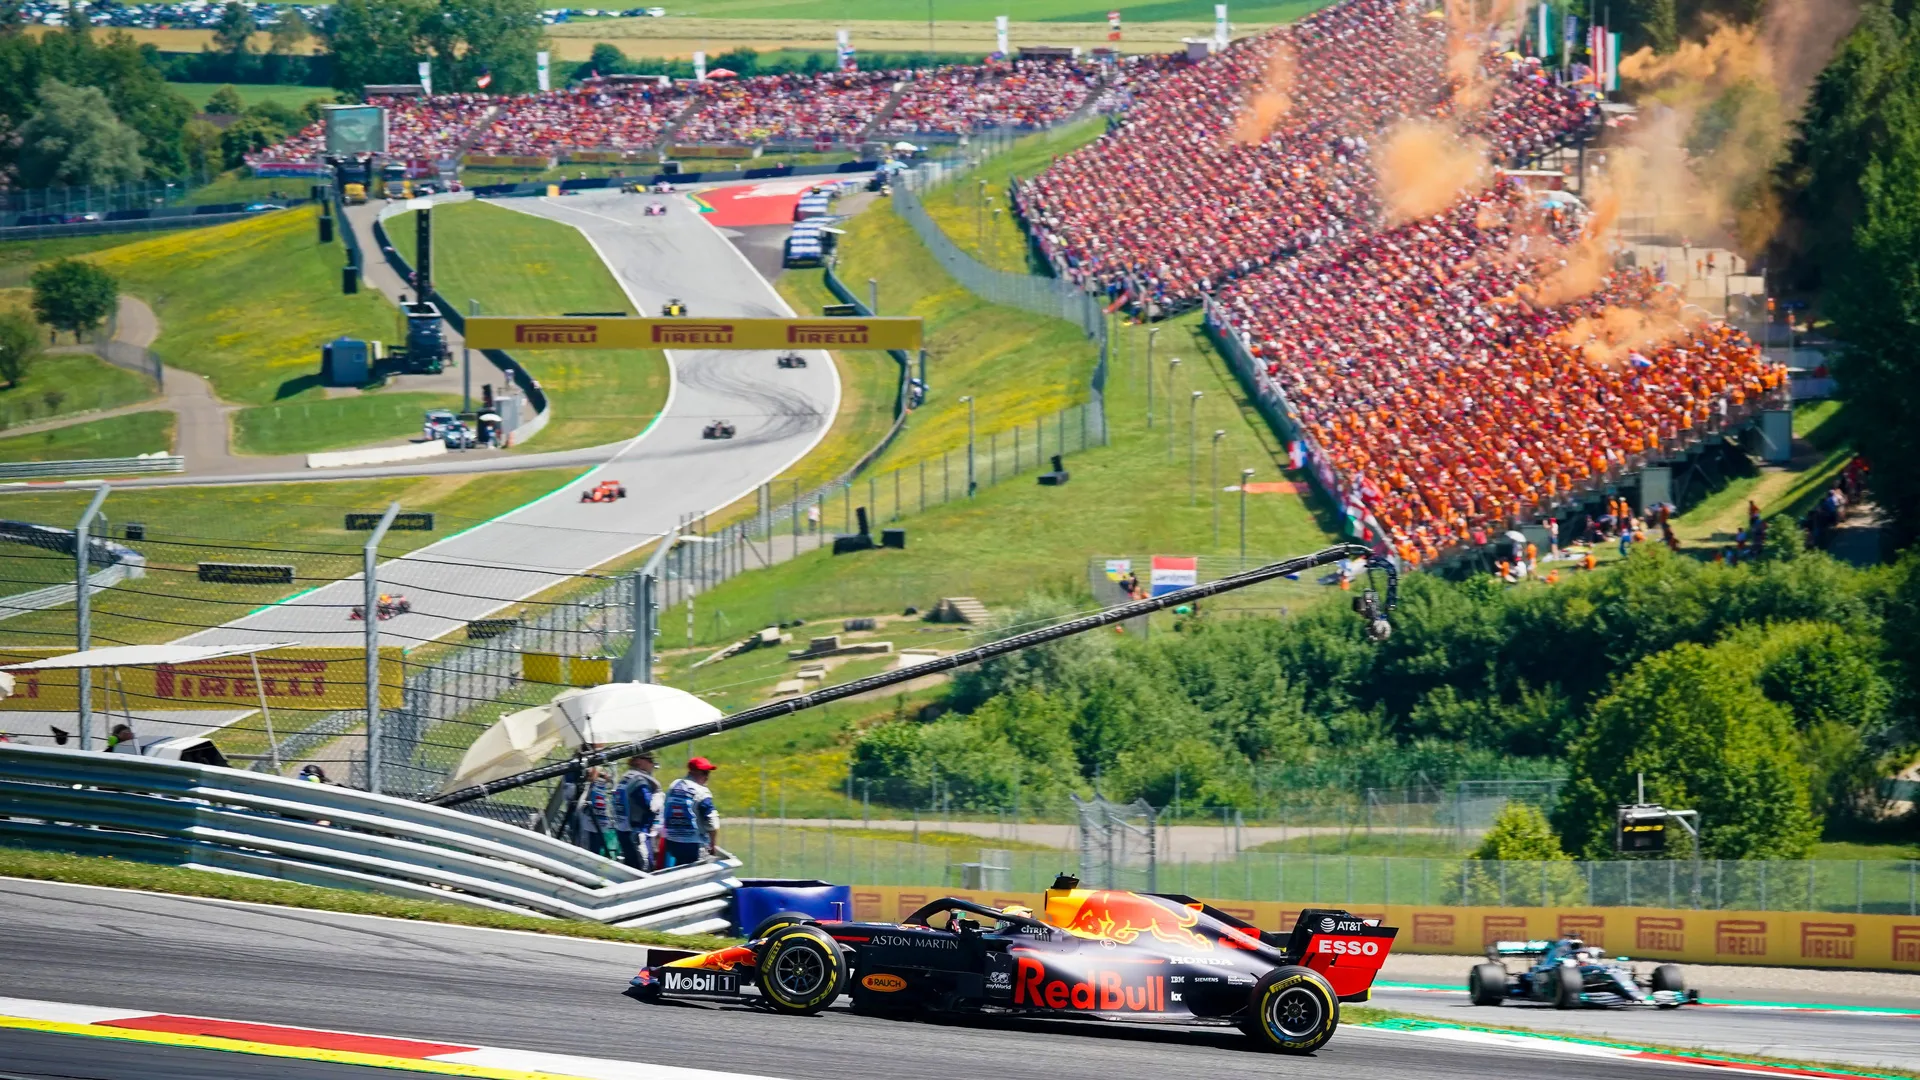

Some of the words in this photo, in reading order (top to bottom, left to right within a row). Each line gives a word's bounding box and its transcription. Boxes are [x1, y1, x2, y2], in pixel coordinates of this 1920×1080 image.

[515, 324, 598, 344] PIRELLI
[651, 324, 734, 344] PIRELLI
[786, 325, 869, 344] PIRELLI
[155, 660, 327, 698] PIRELLI
[1337, 921, 1362, 931] AT&T
[1636, 916, 1684, 951] PIRELLI
[871, 935, 911, 947] ASTON
[915, 938, 959, 950] MARTIN
[1716, 919, 1767, 956] PIRELLI
[1801, 922, 1855, 959] PIRELLI
[1319, 940, 1379, 956] ESSO
[1170, 956, 1234, 966] HONDA
[664, 972, 716, 991] Mobil
[722, 976, 730, 990] 1
[873, 978, 902, 988] RAUCH
